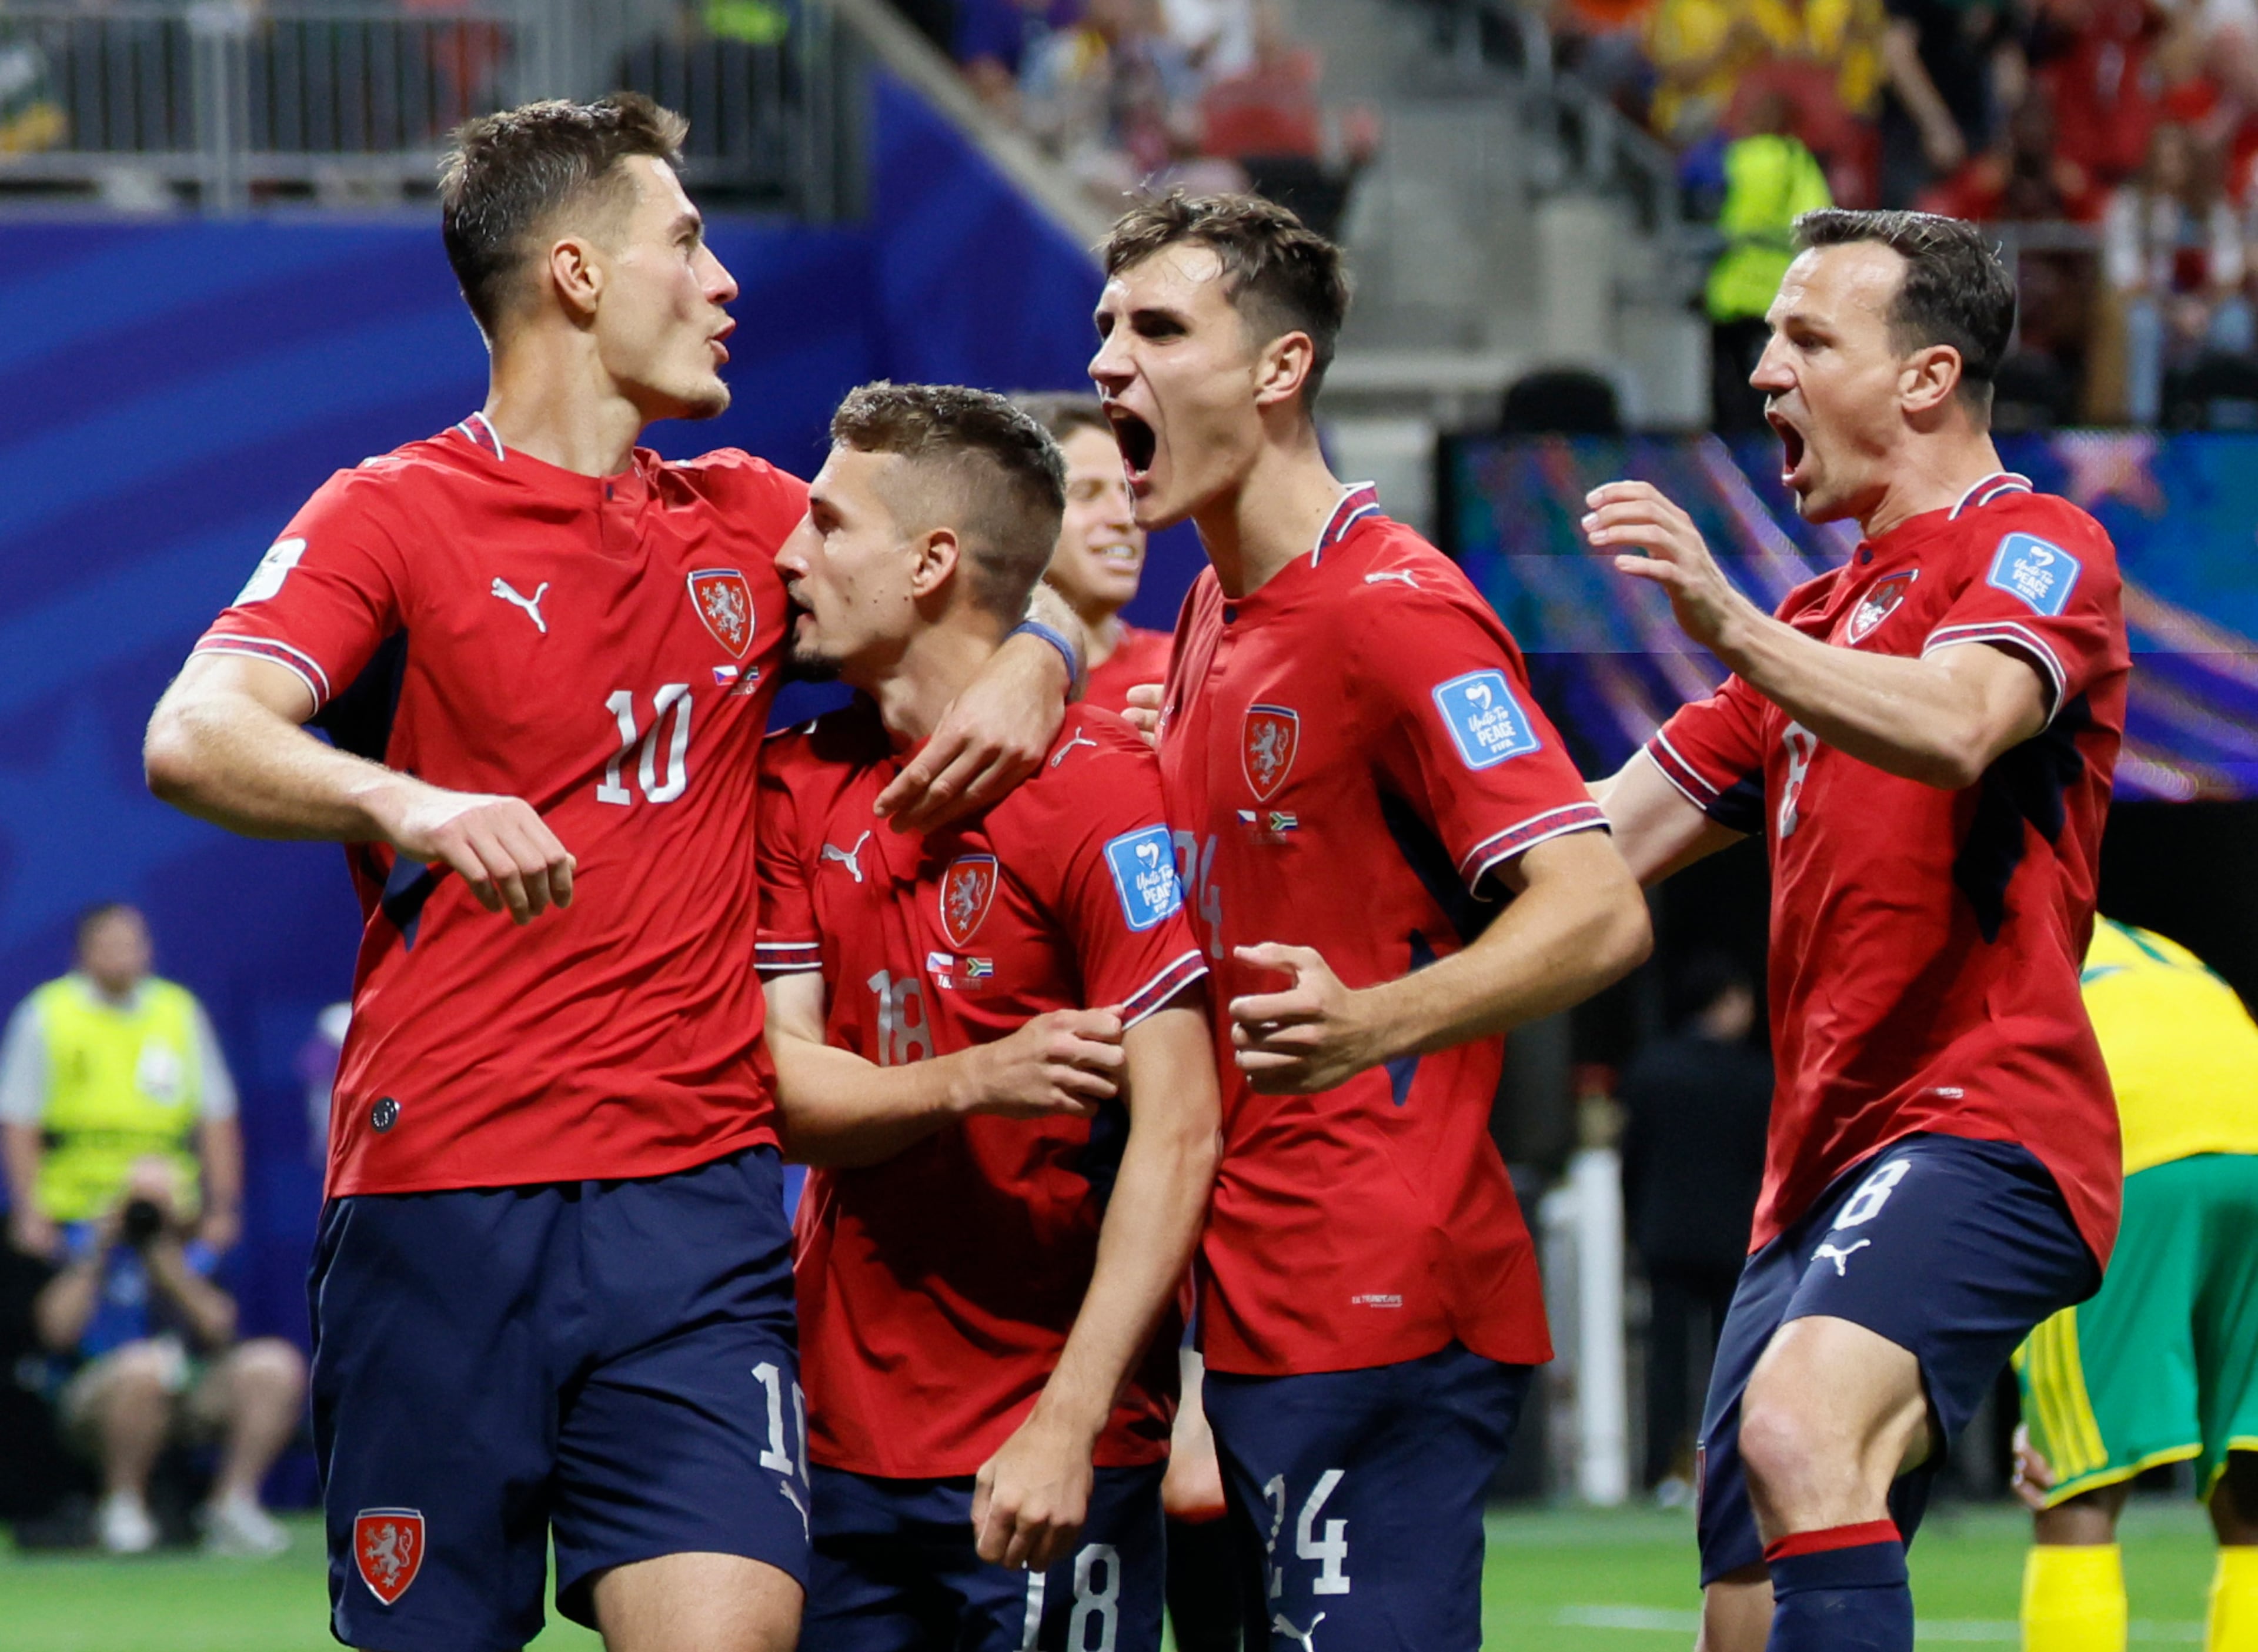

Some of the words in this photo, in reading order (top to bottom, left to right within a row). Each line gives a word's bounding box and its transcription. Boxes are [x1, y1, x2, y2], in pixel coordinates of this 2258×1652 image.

[2013, 568, 2049, 598] PEACE
[597, 683, 693, 805] 10
[1477, 721, 1516, 747] PEACE
[1779, 719, 1817, 839] 8
[1143, 881, 1173, 906] PEAC
[867, 969, 935, 1067] 18
[1833, 1159, 1911, 1230] 8
[1264, 1469, 1351, 1599] 24
[1013, 1543, 1120, 1652] 18
